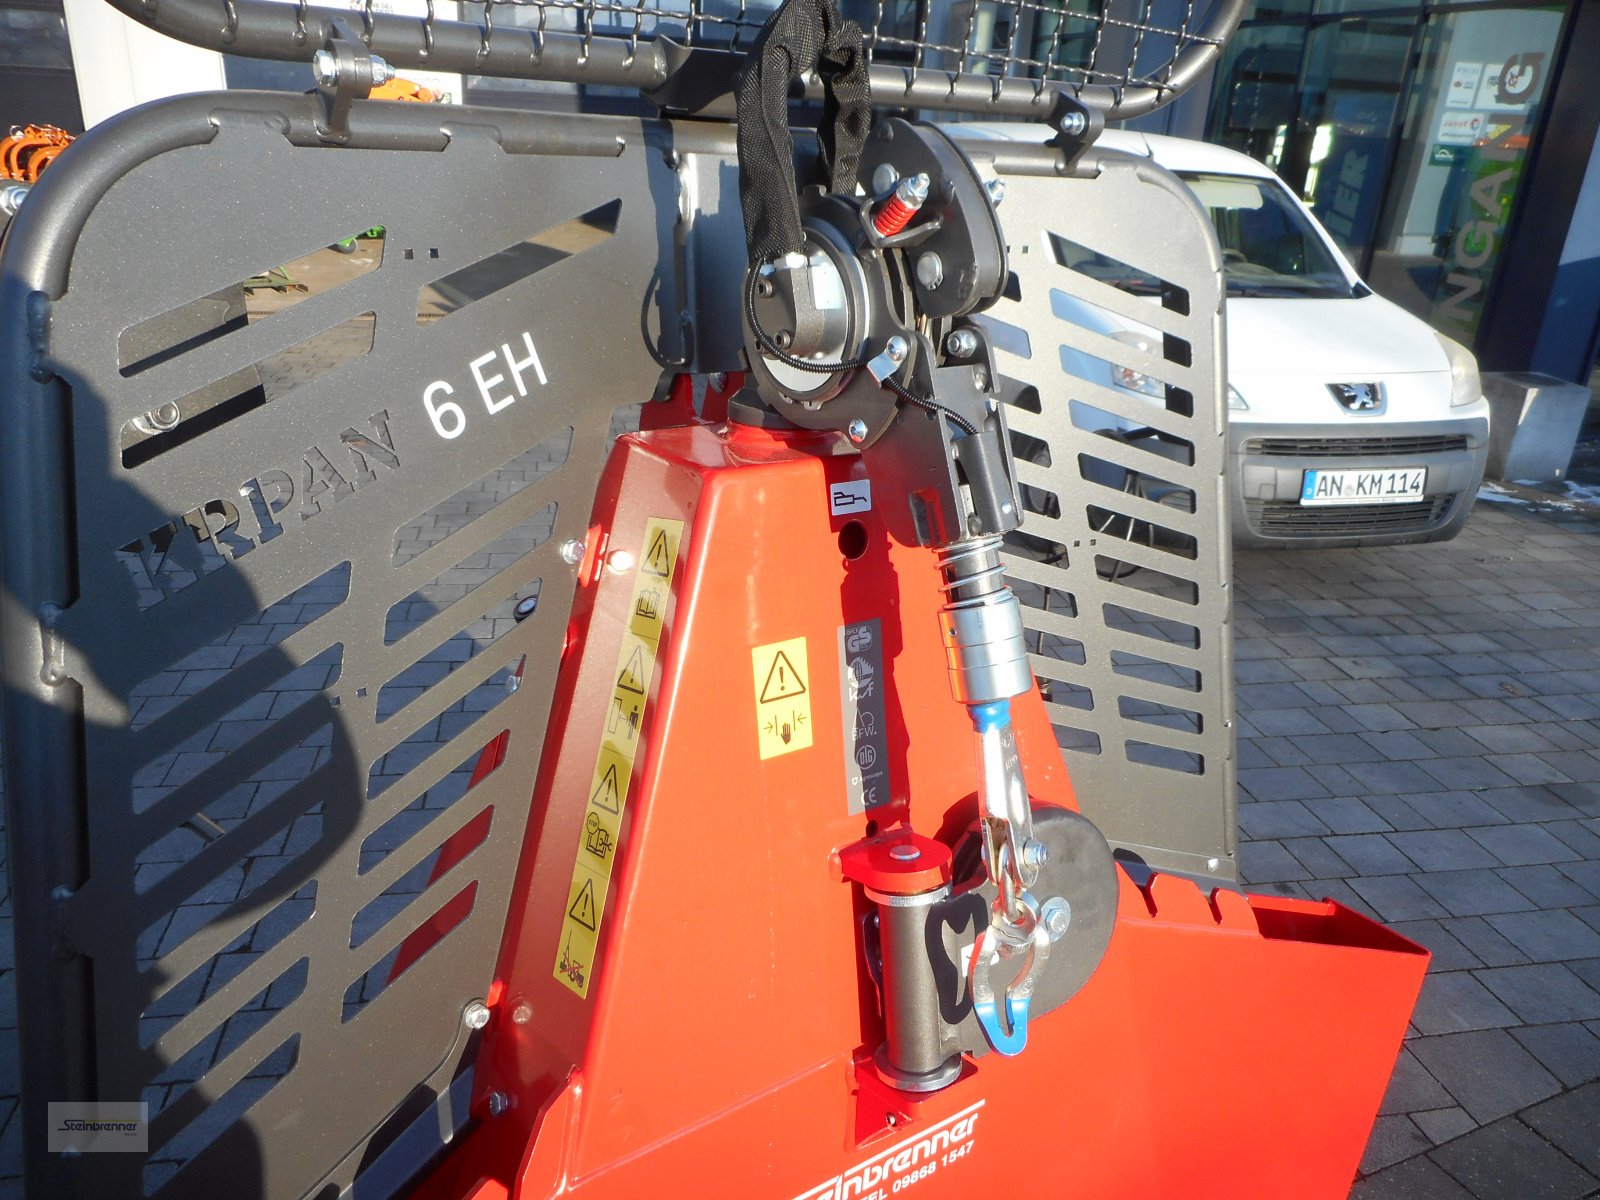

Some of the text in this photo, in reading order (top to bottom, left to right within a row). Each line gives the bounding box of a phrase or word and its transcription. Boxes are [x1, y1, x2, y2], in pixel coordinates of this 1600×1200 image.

[422, 331, 549, 440] 6 EH
[116, 409, 401, 613] KRPAN
[1316, 474, 1345, 497] AN
[860, 786, 877, 806] CE
[892, 1160, 937, 1194] 09868
[941, 1139, 975, 1168] 1547
